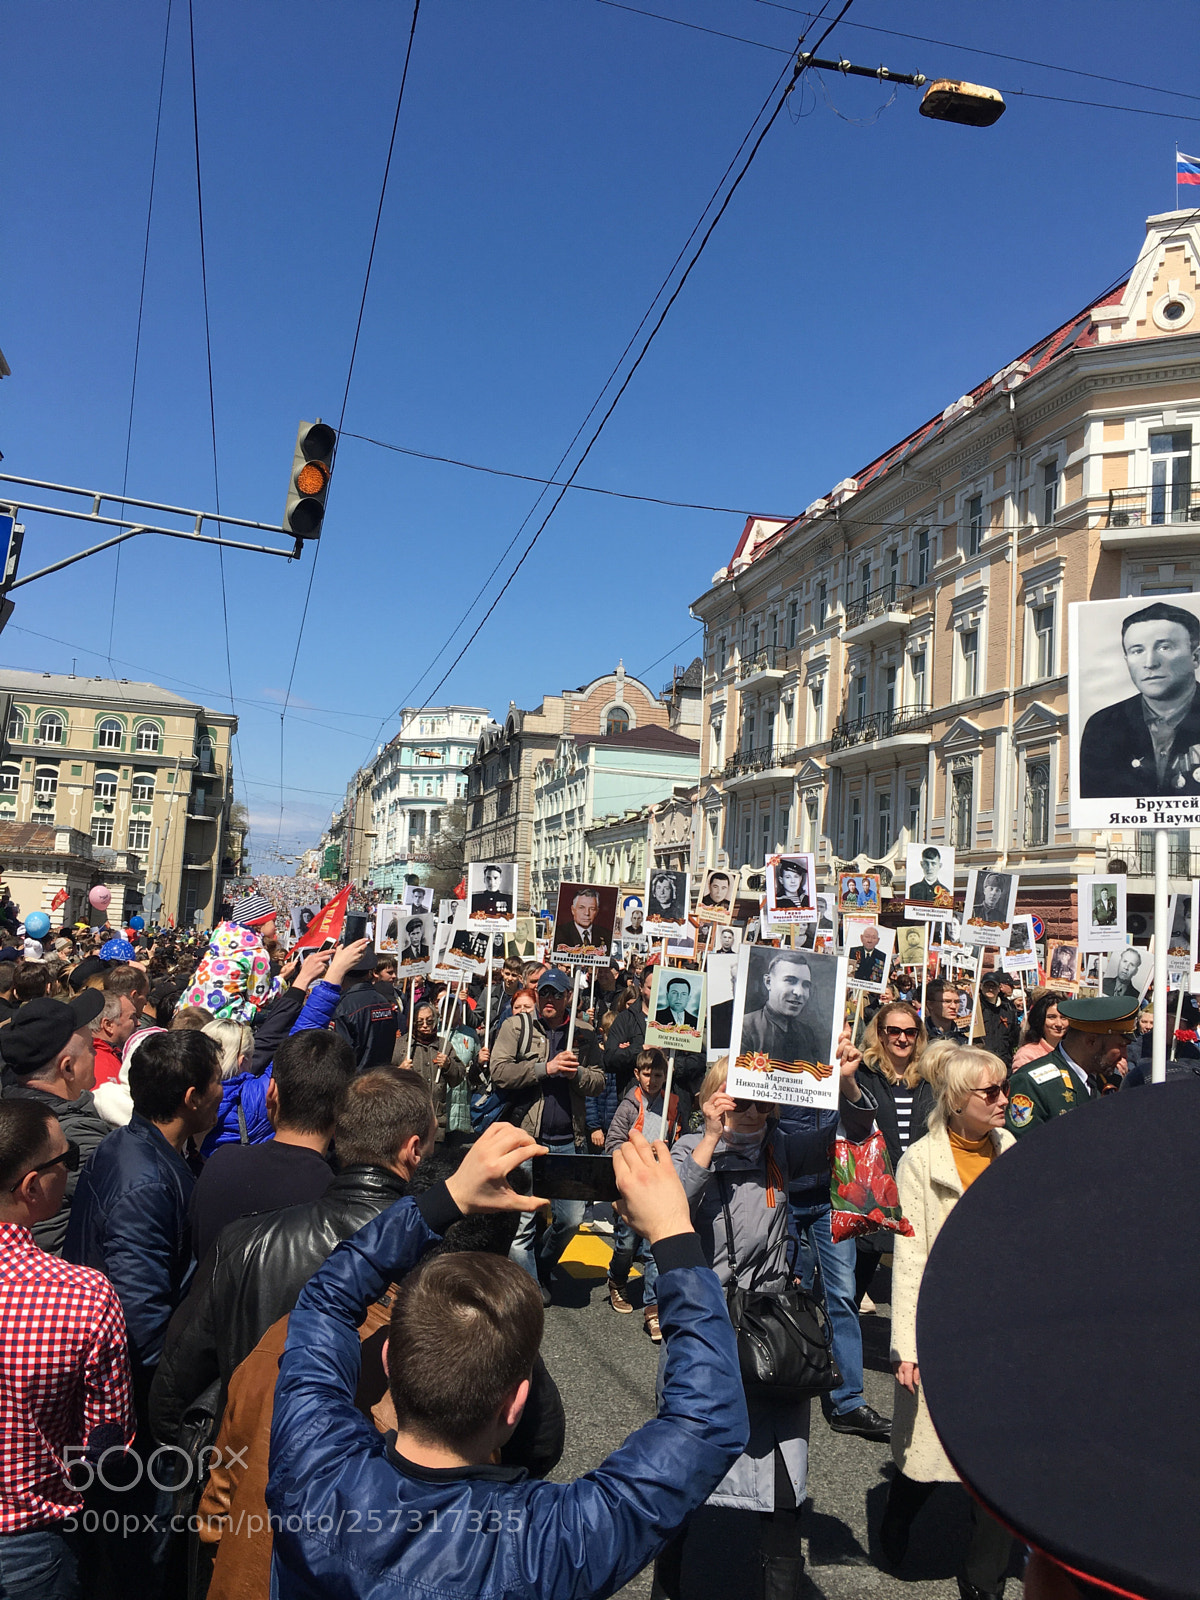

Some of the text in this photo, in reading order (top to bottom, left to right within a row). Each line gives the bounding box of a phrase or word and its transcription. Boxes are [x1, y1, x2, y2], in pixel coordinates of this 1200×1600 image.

[1136, 798, 1199, 811] Брухтей
[1109, 813, 1148, 824] Яков
[658, 1034, 690, 1043] ПОГРЕБНЯК
[765, 1073, 803, 1085] Маргазин
[735, 1078, 832, 1097] Николай Александрович
[752, 1089, 814, 1104] 1904-25.11.1943
